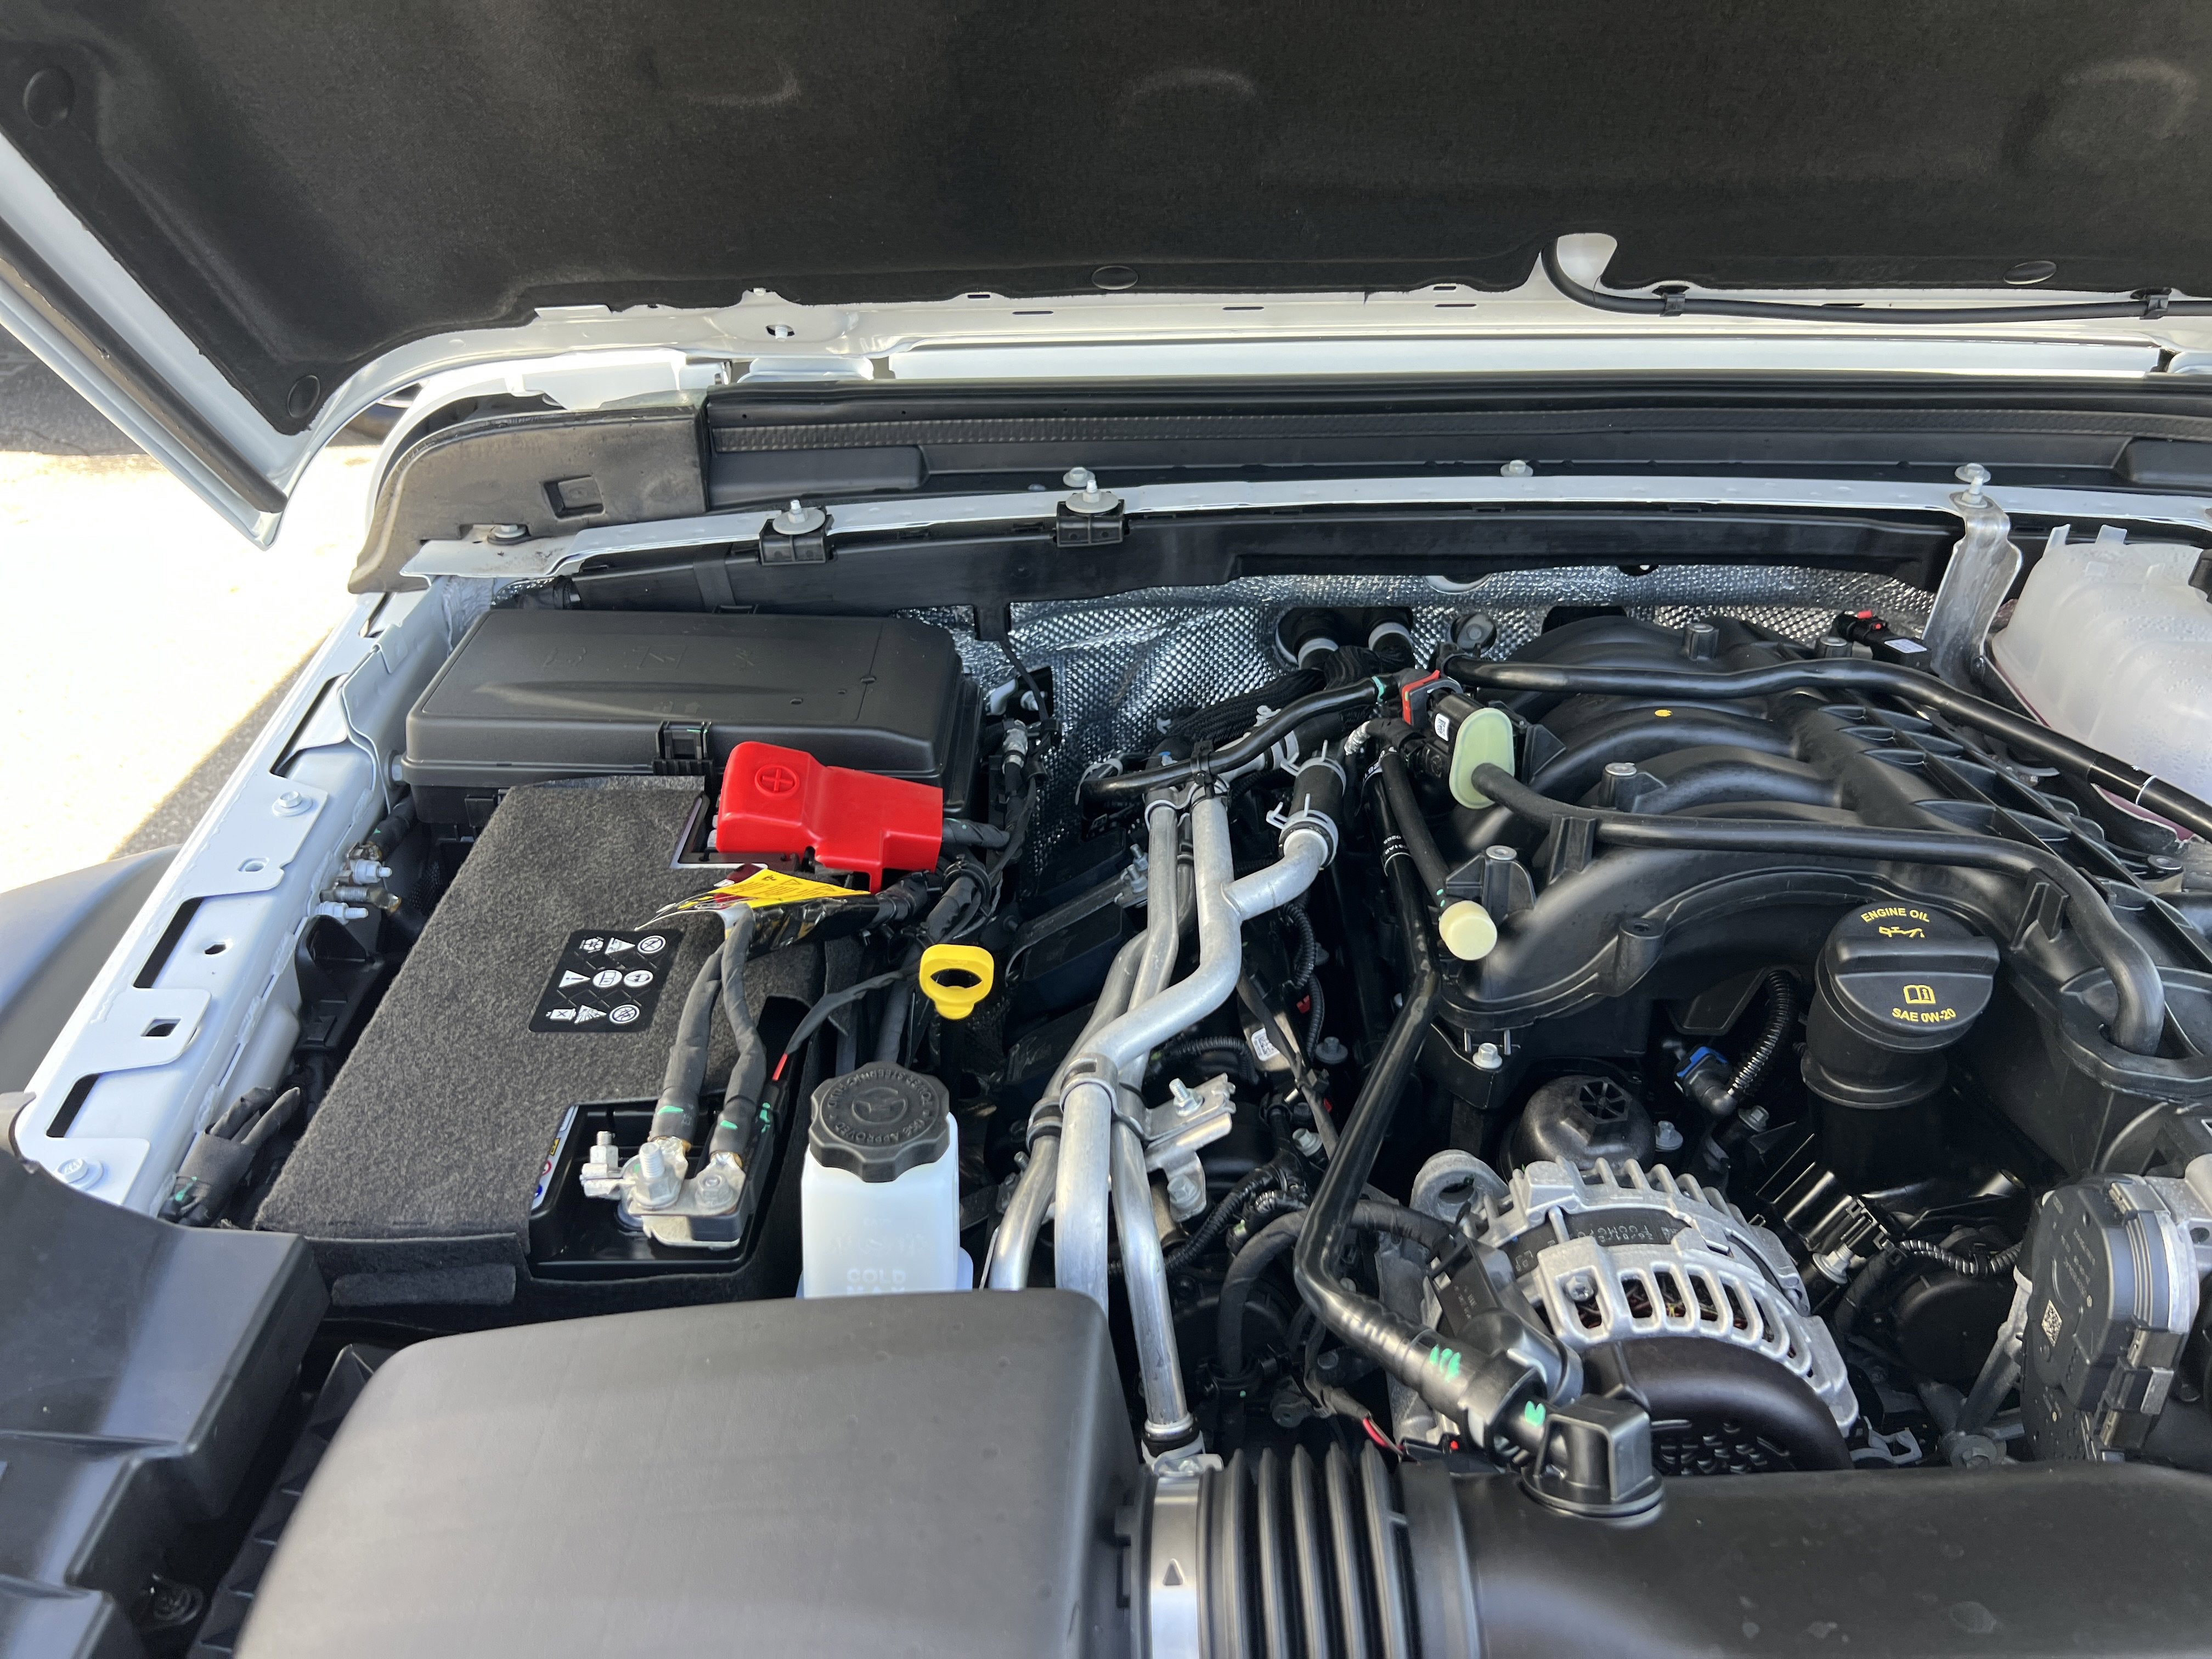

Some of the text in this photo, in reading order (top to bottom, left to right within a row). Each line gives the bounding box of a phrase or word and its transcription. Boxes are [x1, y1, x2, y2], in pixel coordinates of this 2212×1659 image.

[1861, 907, 1930, 923] ENGINE OIL
[1892, 1008, 1956, 1023] SAE 0W-20
[847, 1268, 906, 1284] COLD
